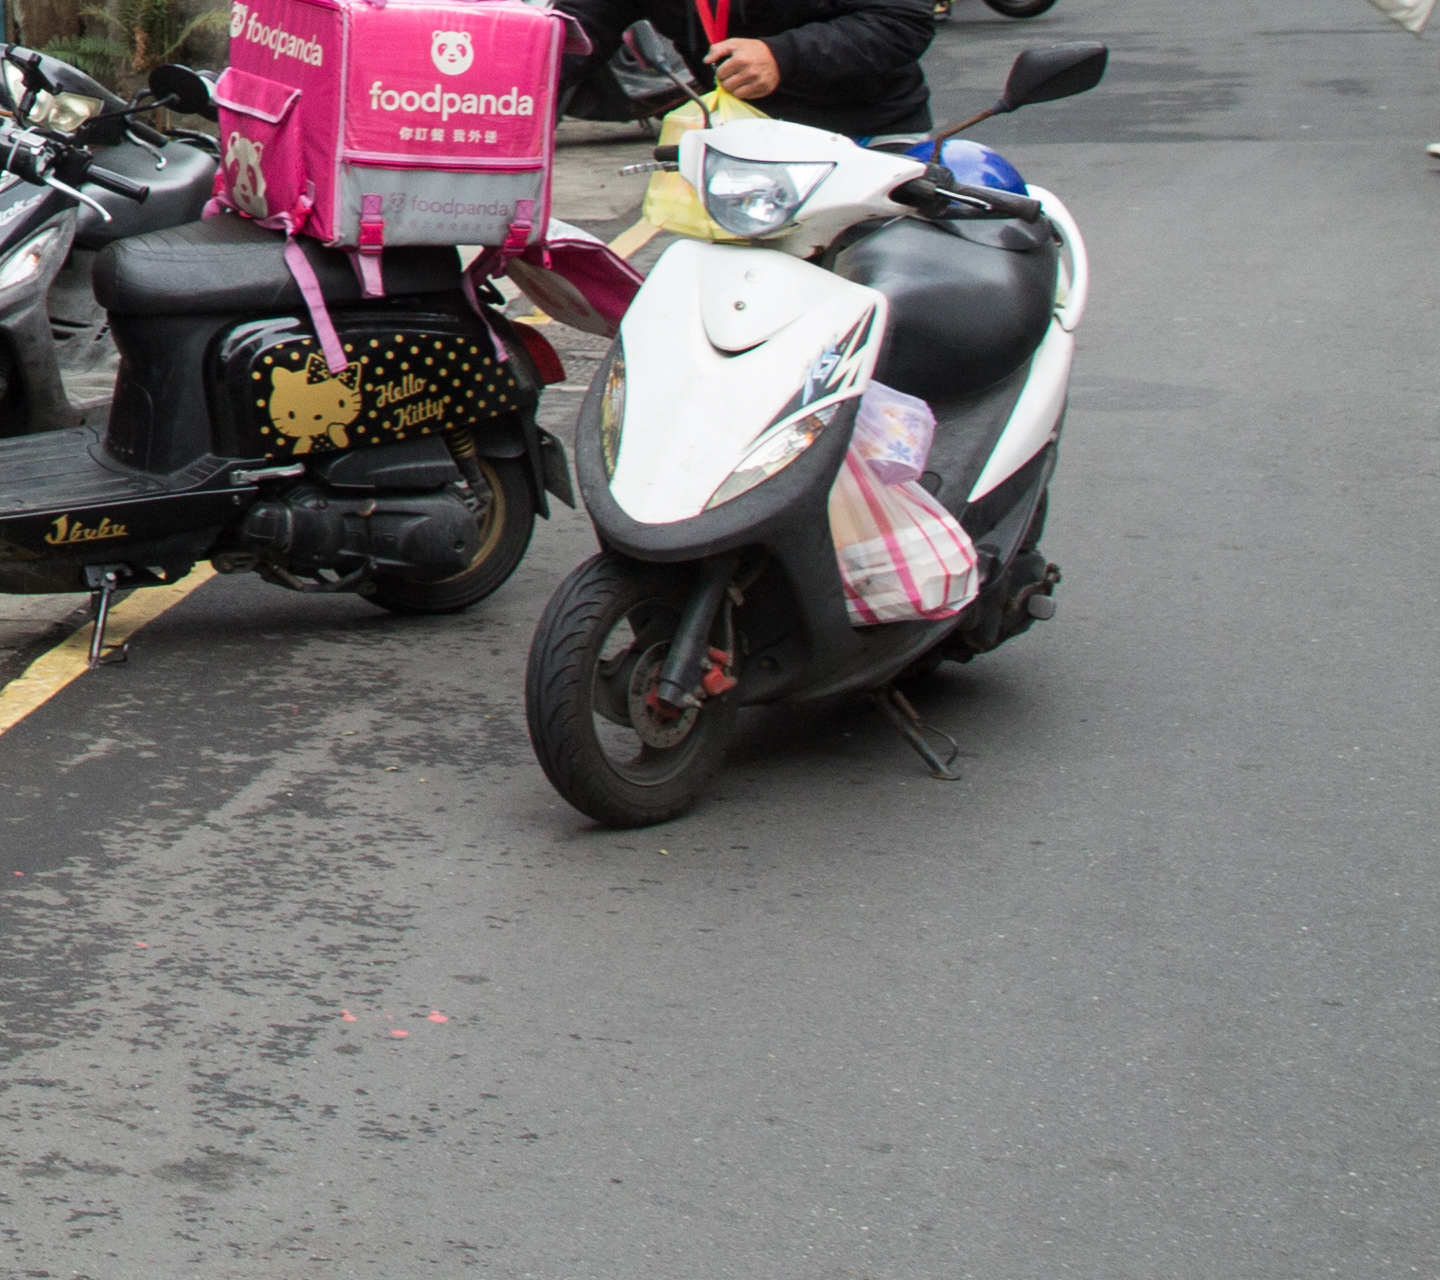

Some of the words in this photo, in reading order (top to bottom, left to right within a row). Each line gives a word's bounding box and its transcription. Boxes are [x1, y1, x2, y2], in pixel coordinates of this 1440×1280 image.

[245, 11, 324, 68] foodpanda
[368, 81, 534, 121] foodpanda
[411, 195, 509, 222] foodpanda
[374, 374, 428, 409] Hello
[391, 396, 447, 432] Kitty
